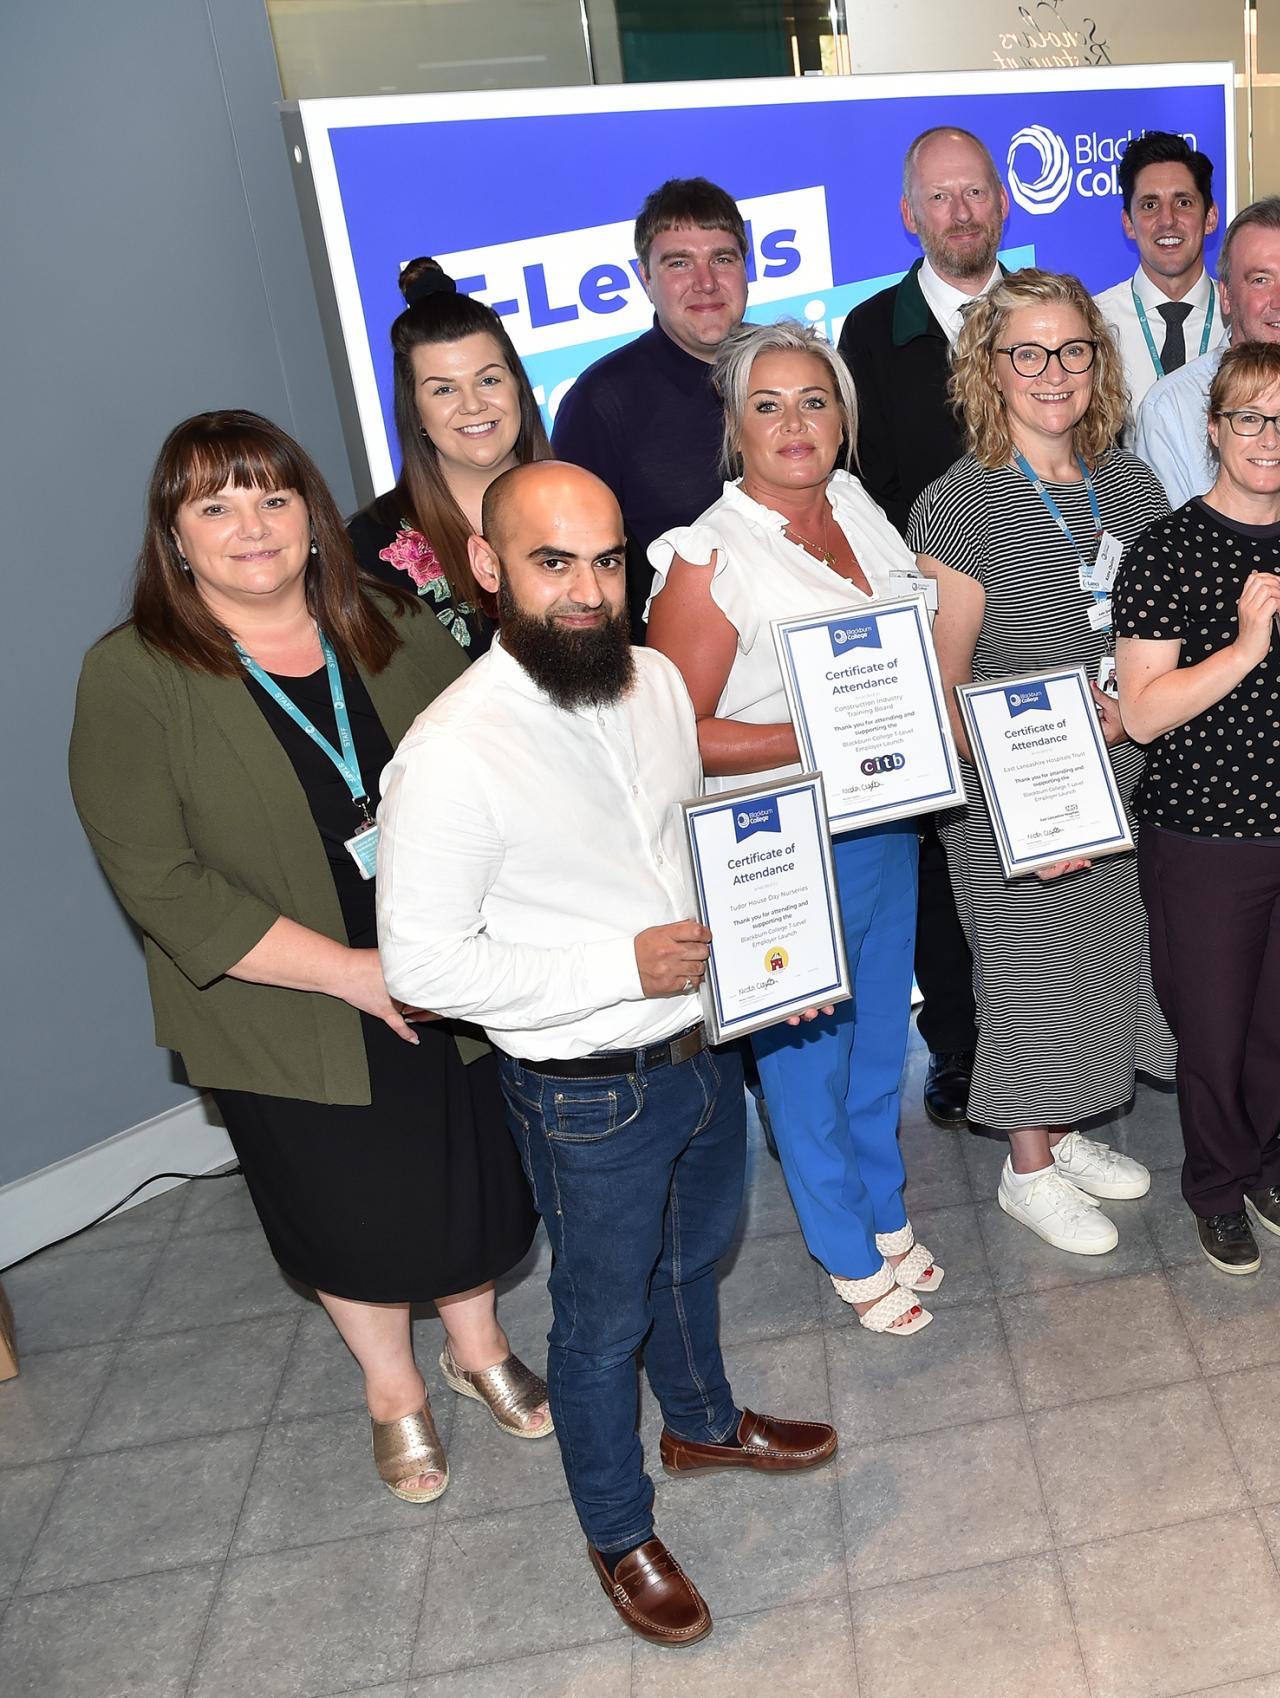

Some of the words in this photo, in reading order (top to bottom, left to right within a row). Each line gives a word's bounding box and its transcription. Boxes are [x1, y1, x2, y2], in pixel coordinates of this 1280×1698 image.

[1075, 129, 1198, 164] Blacn
[847, 631, 867, 640] College
[825, 664, 884, 680] Certificate
[887, 658, 897, 669] of
[832, 676, 898, 695] Attendance
[274, 692, 295, 712] STAFF
[834, 700, 875, 712] Construction
[876, 695, 903, 704] Industry
[847, 709, 873, 718] Training
[874, 703, 893, 712] Board
[874, 714, 903, 724] attending
[342, 727, 350, 747] STAFF
[855, 725, 887, 735] supporting
[1004, 723, 1054, 739] Certificate
[1057, 719, 1066, 728] of
[882, 738, 904, 747] Launch
[1011, 735, 1067, 751] Attendance
[861, 751, 905, 774] citb
[338, 763, 356, 784] STAFF
[1050, 768, 1074, 777] attending
[1033, 777, 1060, 787] supporting
[749, 813, 769, 824] College
[728, 849, 782, 870] Certificate
[785, 843, 795, 855] of
[733, 862, 794, 886] Attendance
[730, 903, 746, 911] Tudor
[748, 897, 766, 907] House
[781, 886, 808, 897] Nurseries
[733, 917, 750, 926] Thank
[751, 915, 761, 923] you
[771, 904, 797, 915] attending
[752, 917, 782, 929] supporting
[741, 931, 767, 943] Blackburn
[768, 925, 788, 935] College
[752, 937, 776, 948] Employer
[778, 930, 797, 940] Launch
